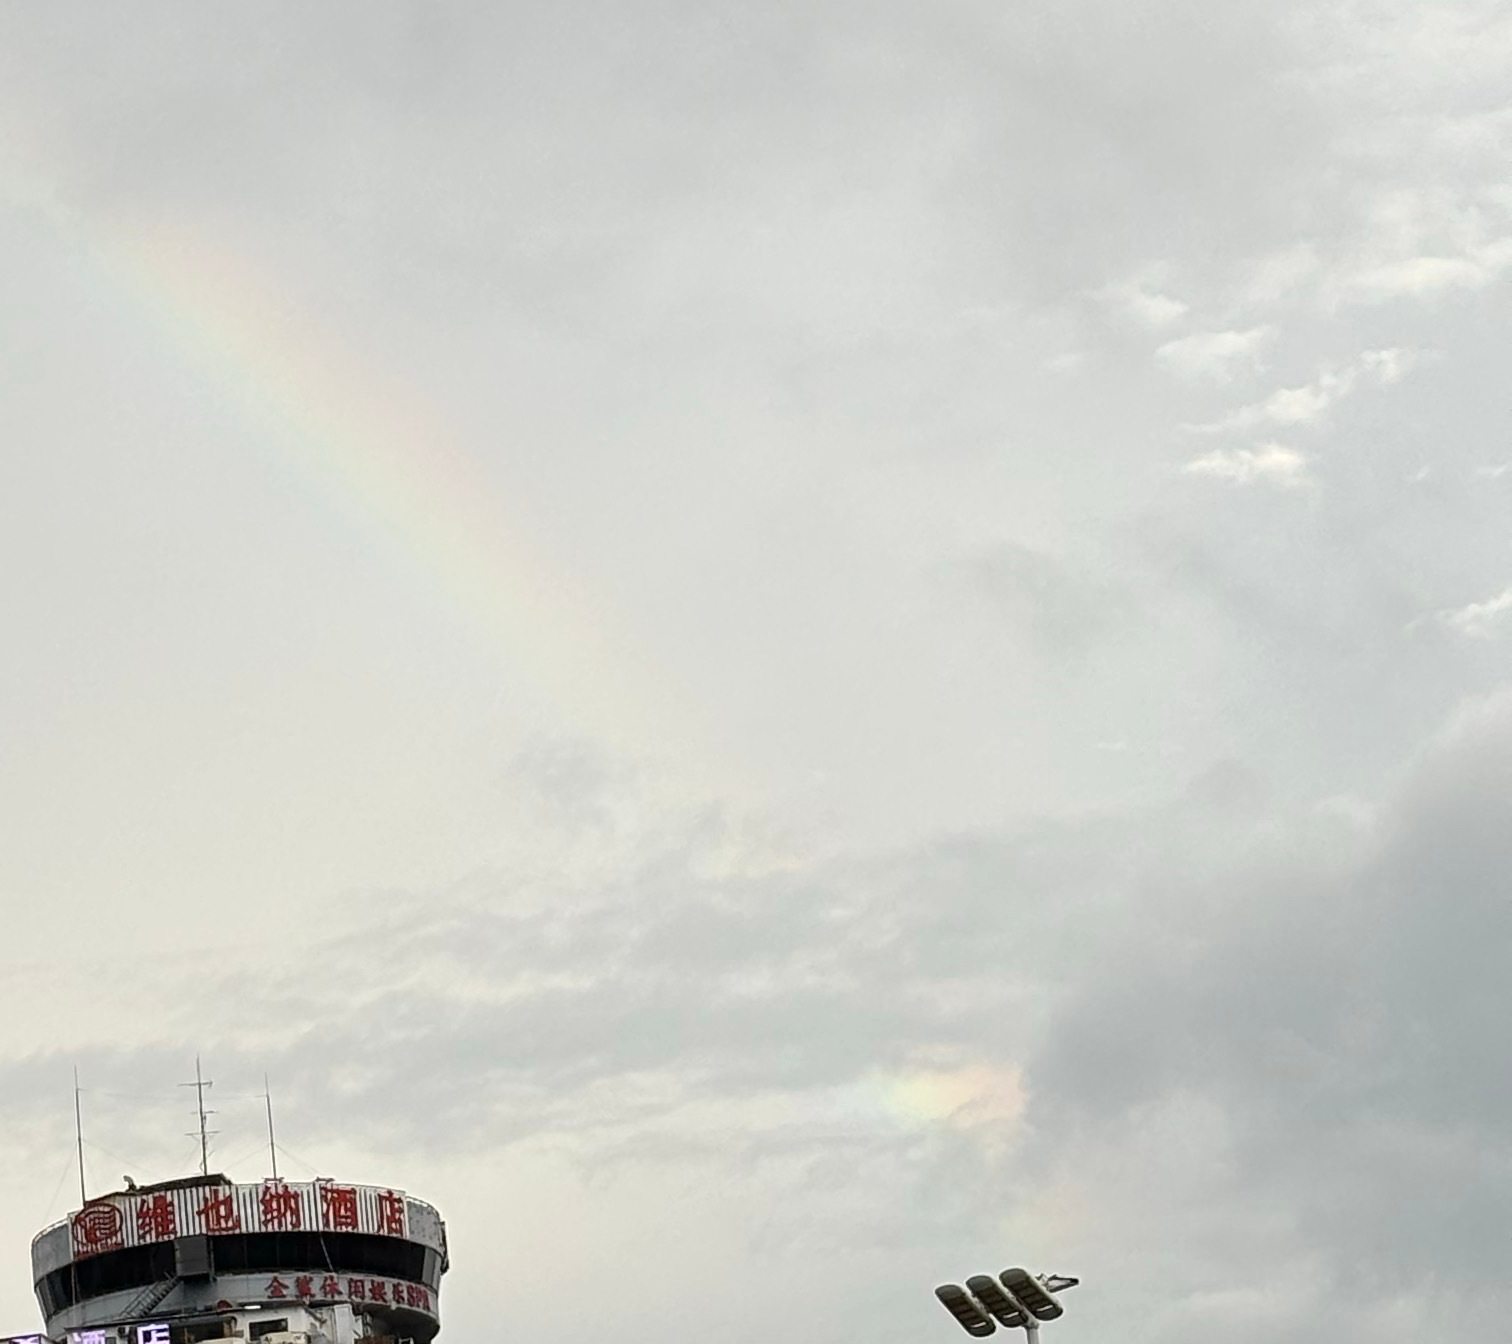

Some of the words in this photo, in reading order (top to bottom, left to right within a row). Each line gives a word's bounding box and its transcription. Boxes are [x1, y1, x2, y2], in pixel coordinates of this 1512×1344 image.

[137, 1182, 405, 1241] 维也纳酒店
